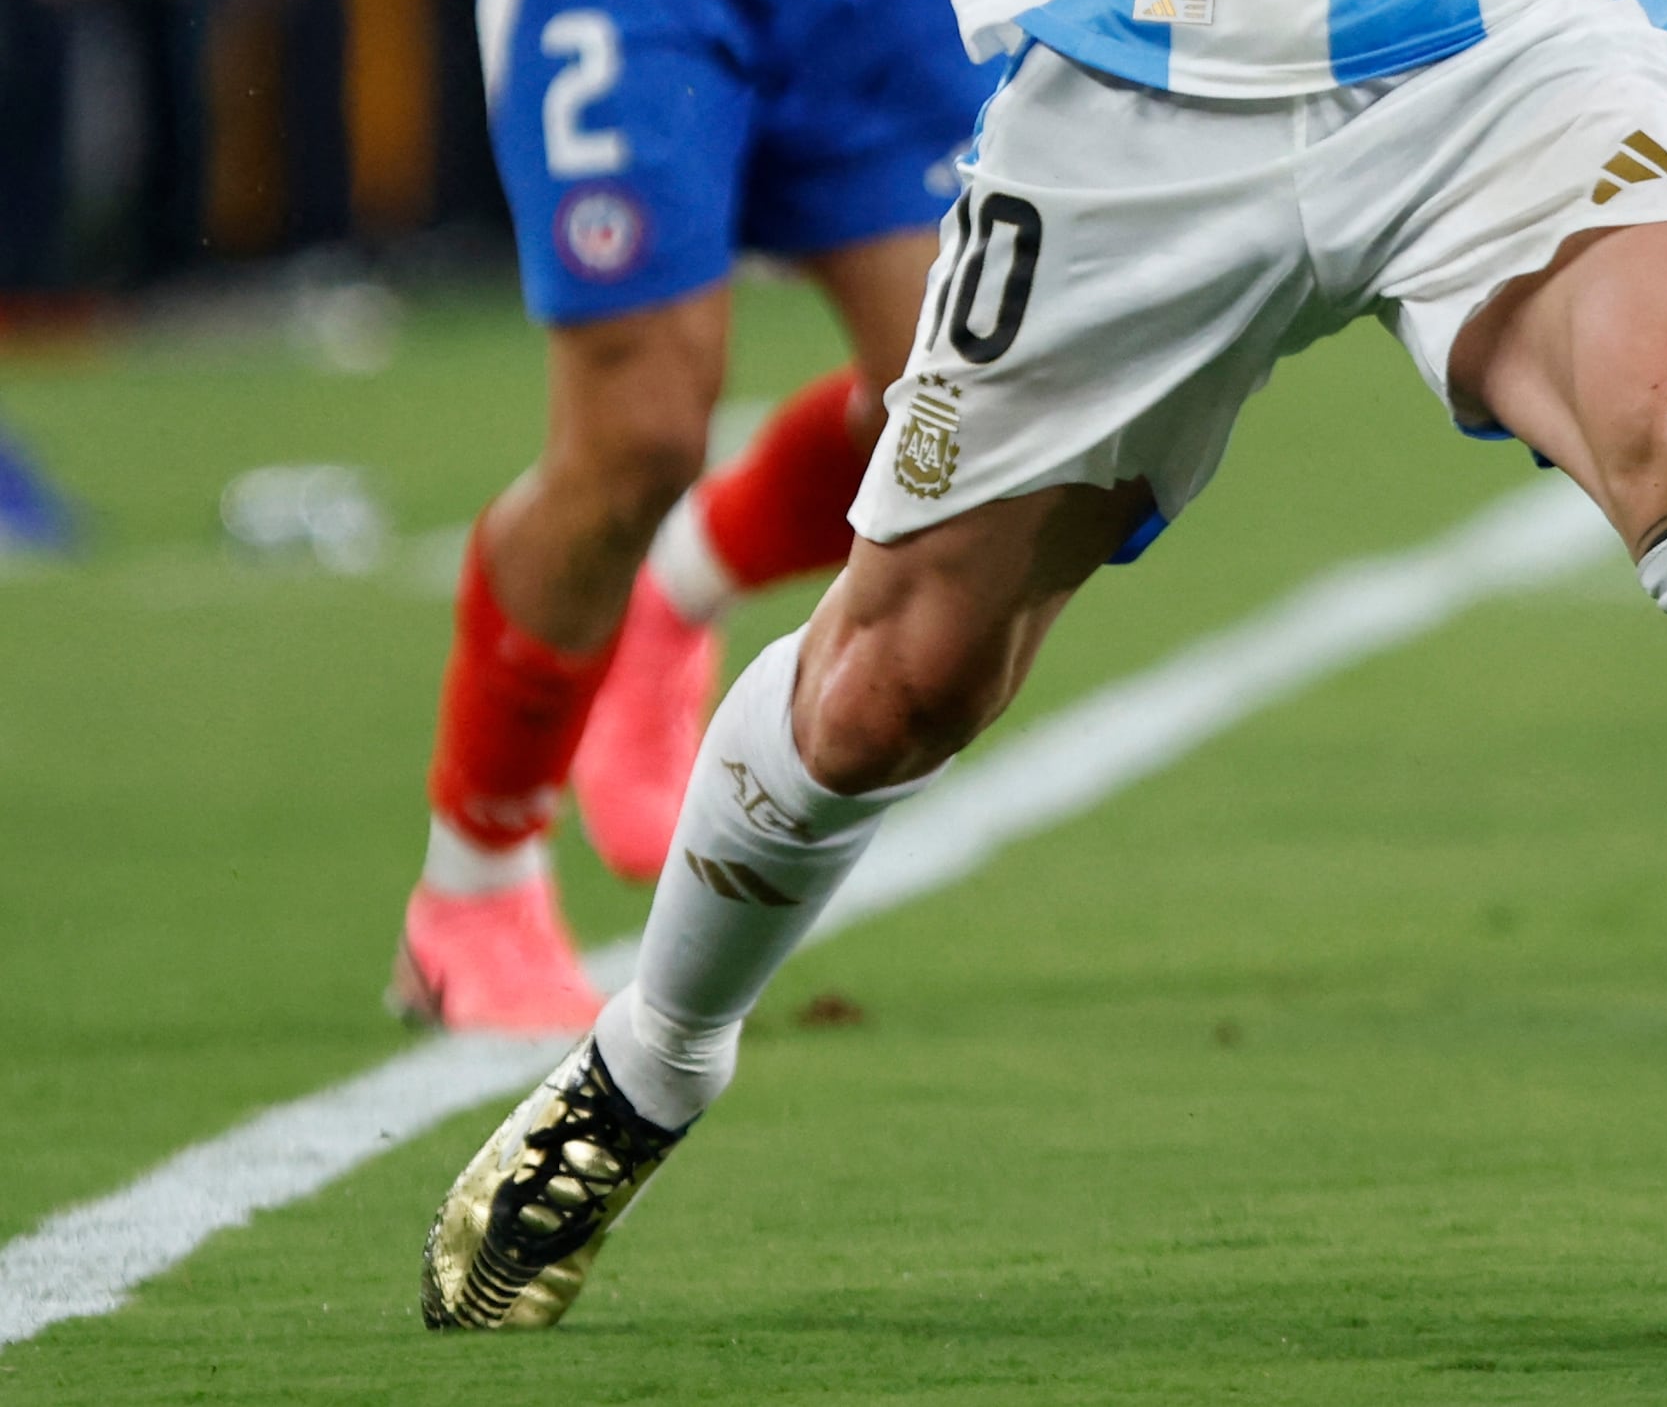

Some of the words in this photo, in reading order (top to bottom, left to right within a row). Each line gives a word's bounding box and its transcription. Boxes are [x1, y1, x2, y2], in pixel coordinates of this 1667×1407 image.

[541, 8, 632, 178] 2
[926, 185, 1042, 365] 10
[905, 419, 940, 473] AFA
